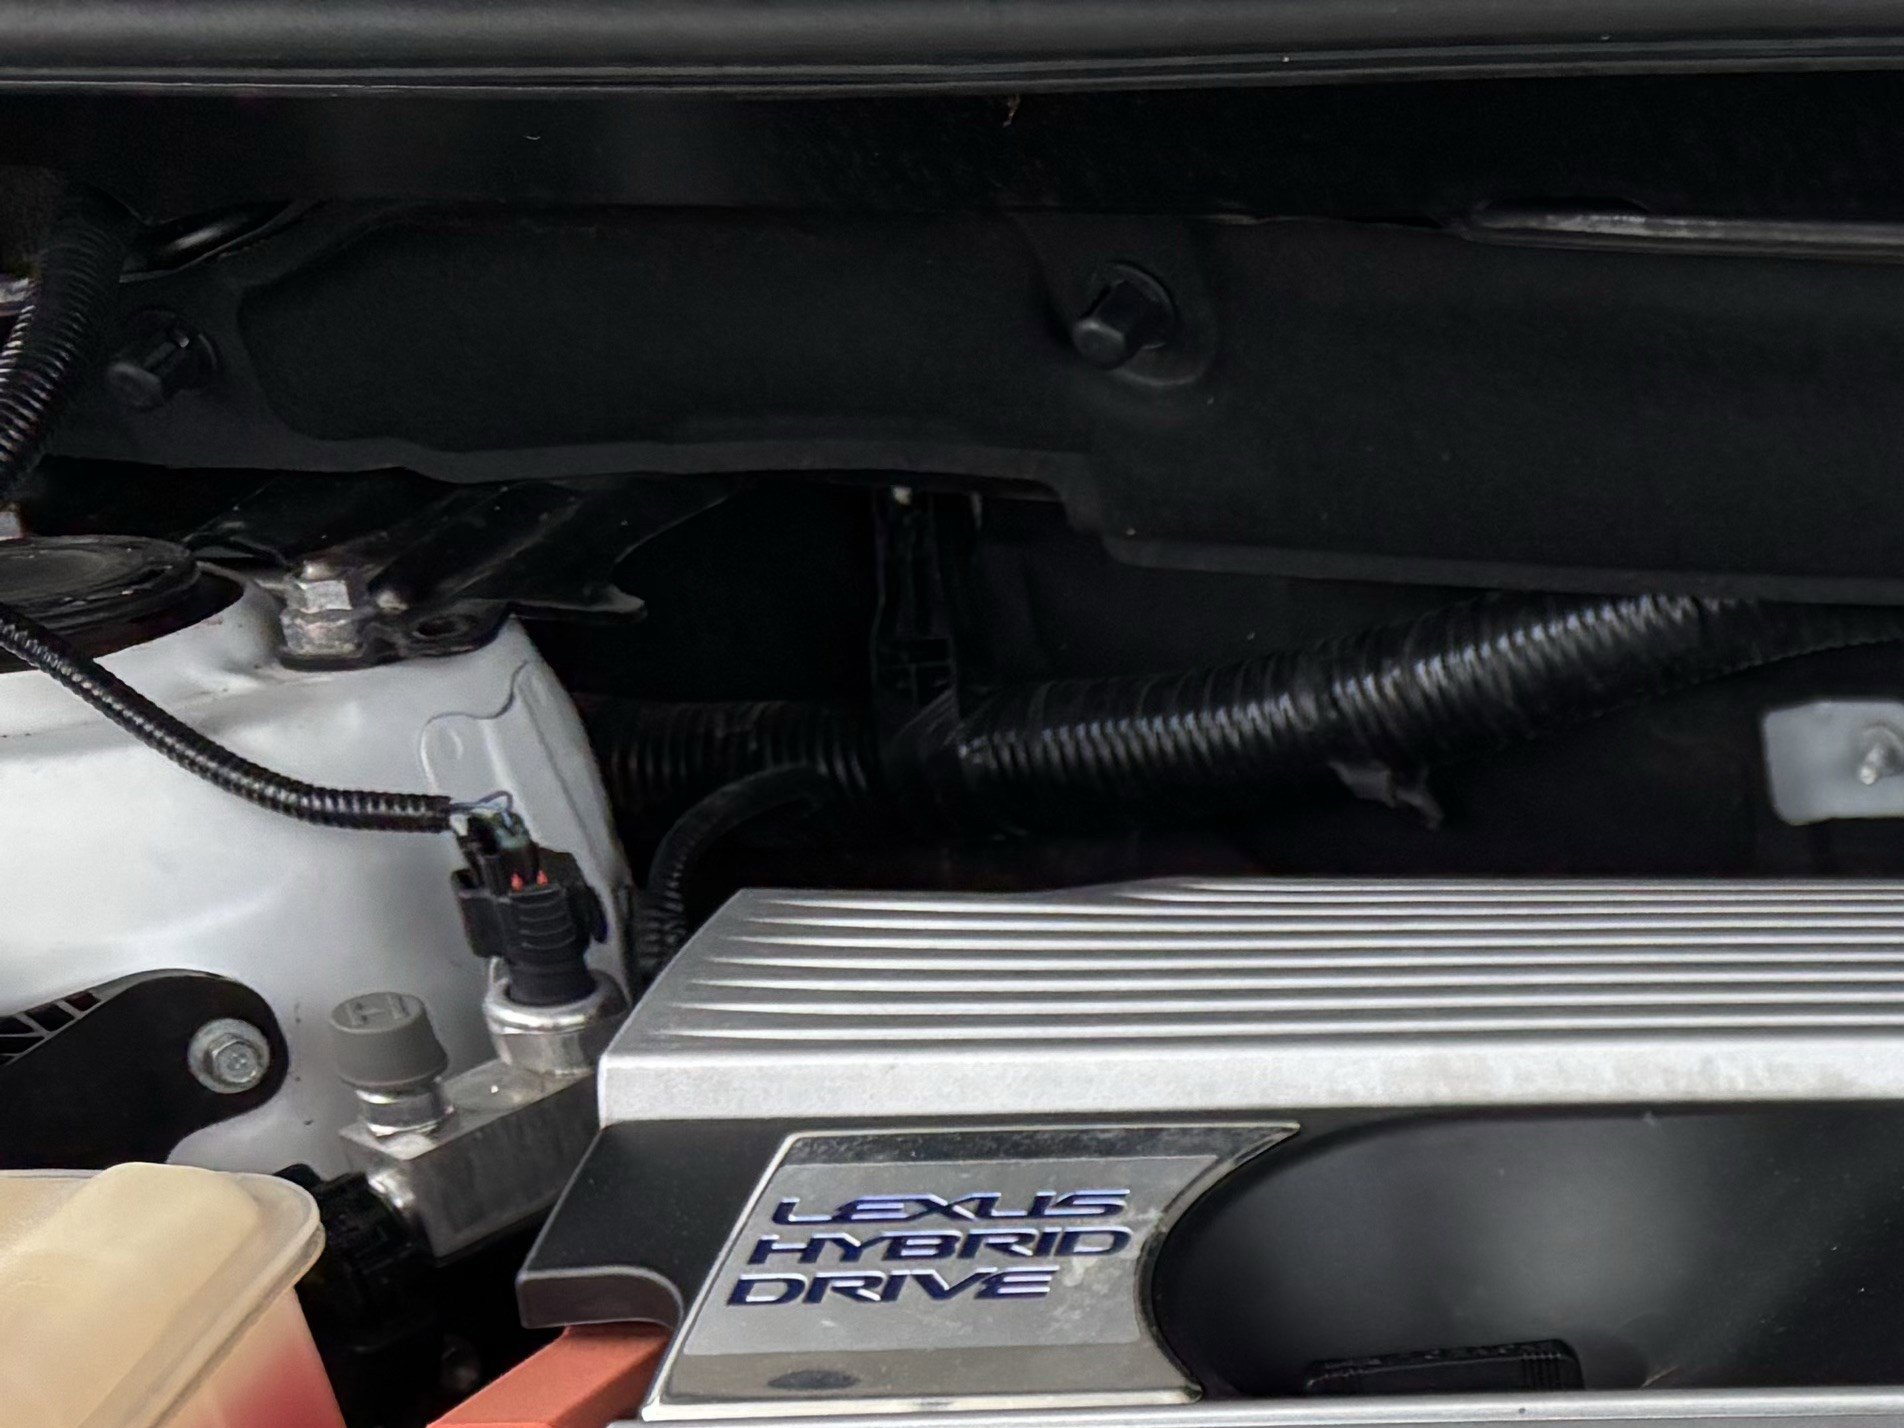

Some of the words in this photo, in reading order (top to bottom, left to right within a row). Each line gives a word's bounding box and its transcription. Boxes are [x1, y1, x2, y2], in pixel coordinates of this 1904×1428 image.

[770, 1188, 1131, 1225] LEXUS
[747, 1225, 1132, 1264] HYBRID
[726, 1265, 1061, 1306] DRIVE
